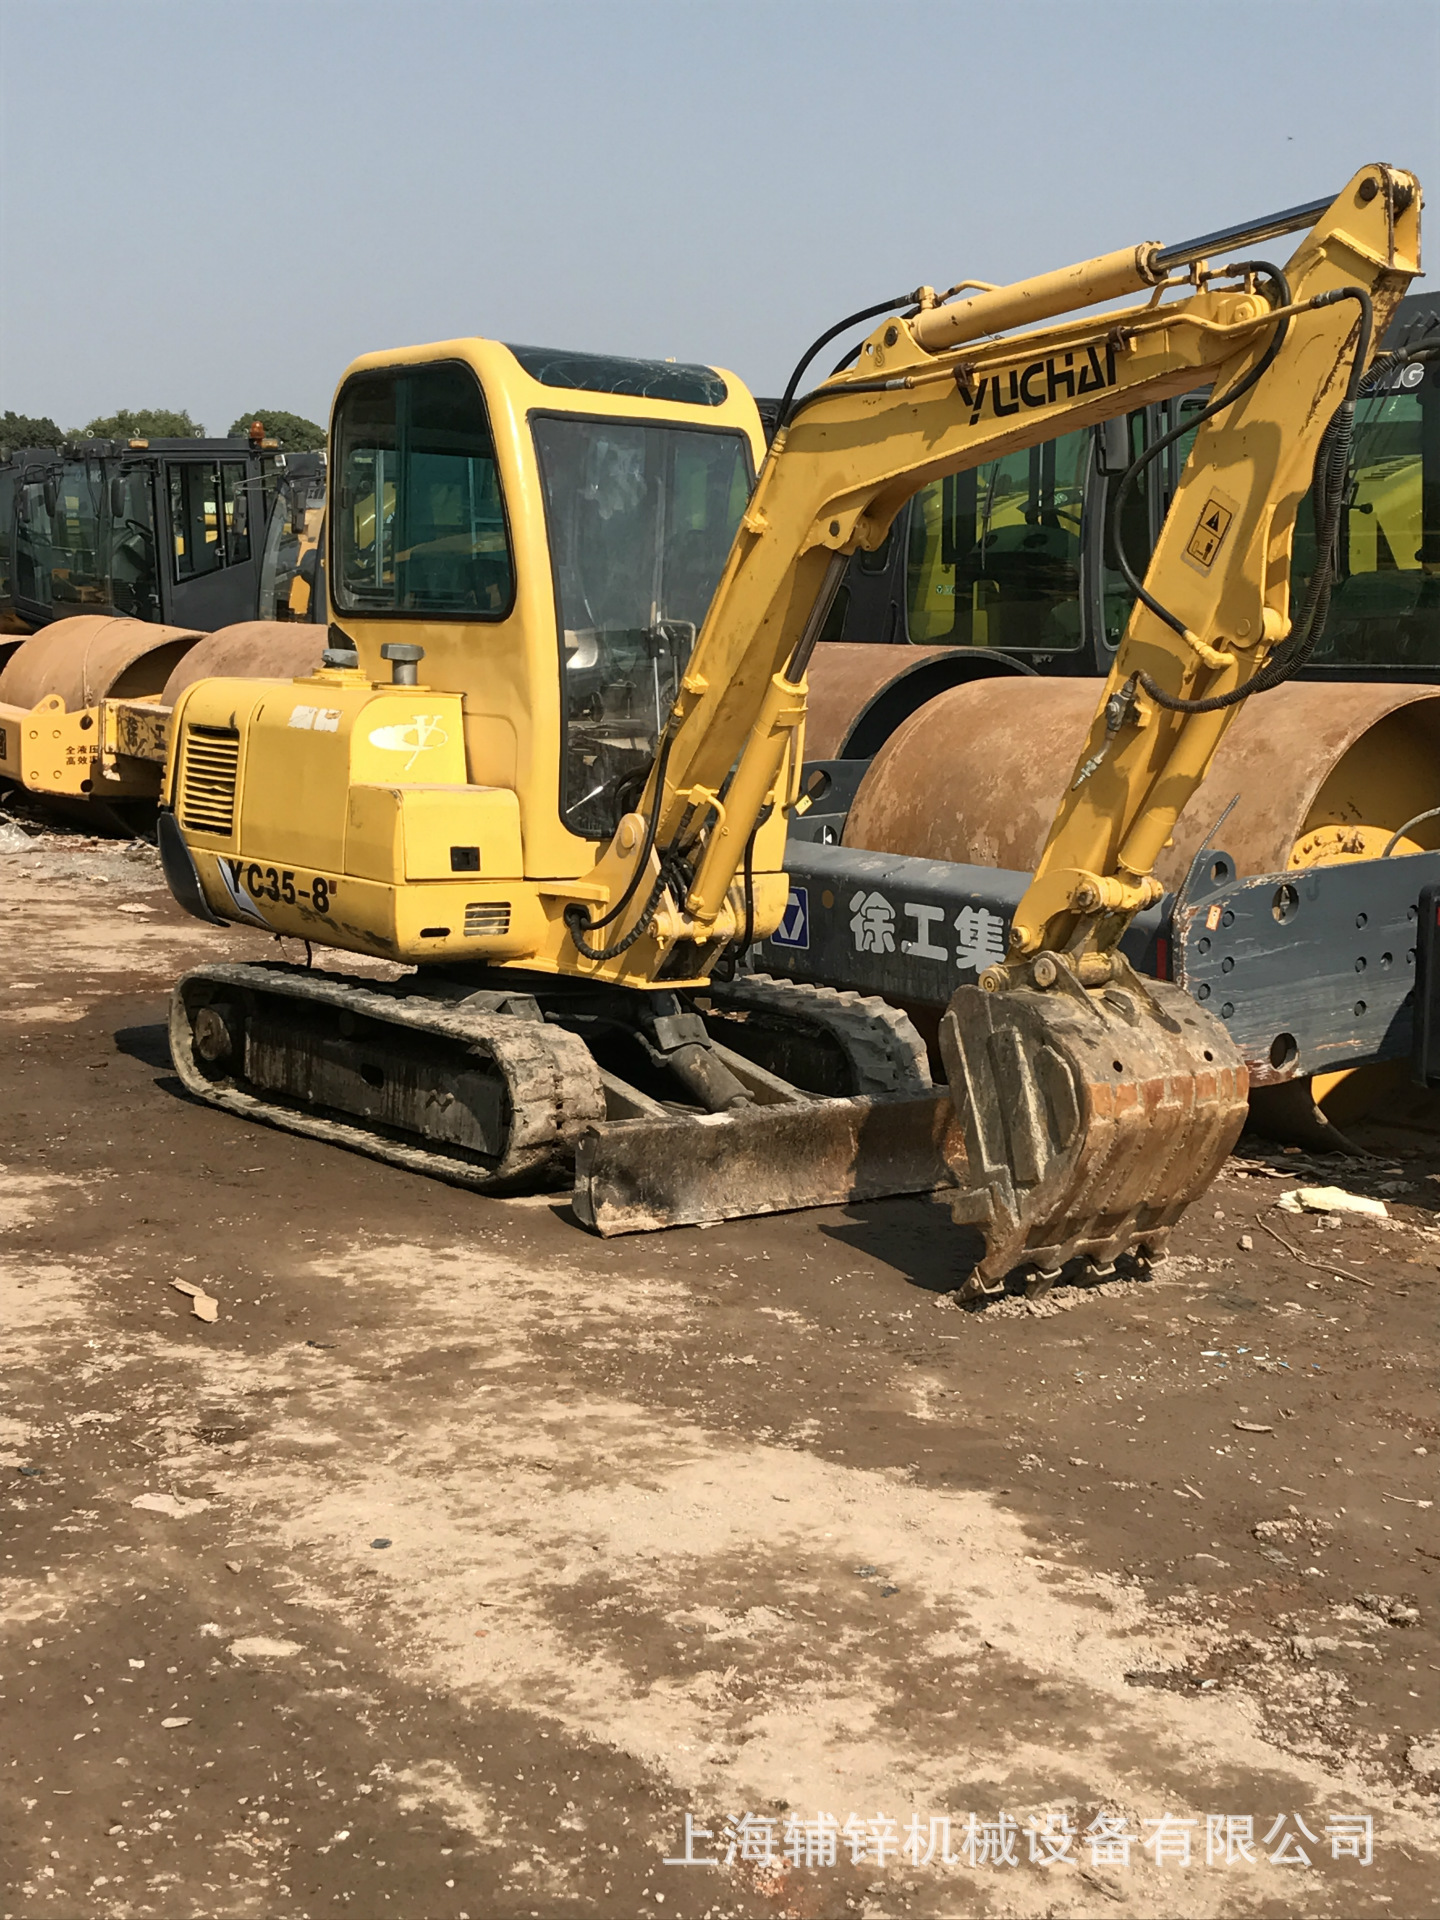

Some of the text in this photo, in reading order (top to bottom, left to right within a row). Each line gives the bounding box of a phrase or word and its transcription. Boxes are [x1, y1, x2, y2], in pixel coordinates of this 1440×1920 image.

[957, 343, 1117, 427] YUCHAI
[227, 858, 330, 914] YC35-8
[849, 890, 1006, 974] 徐工集
